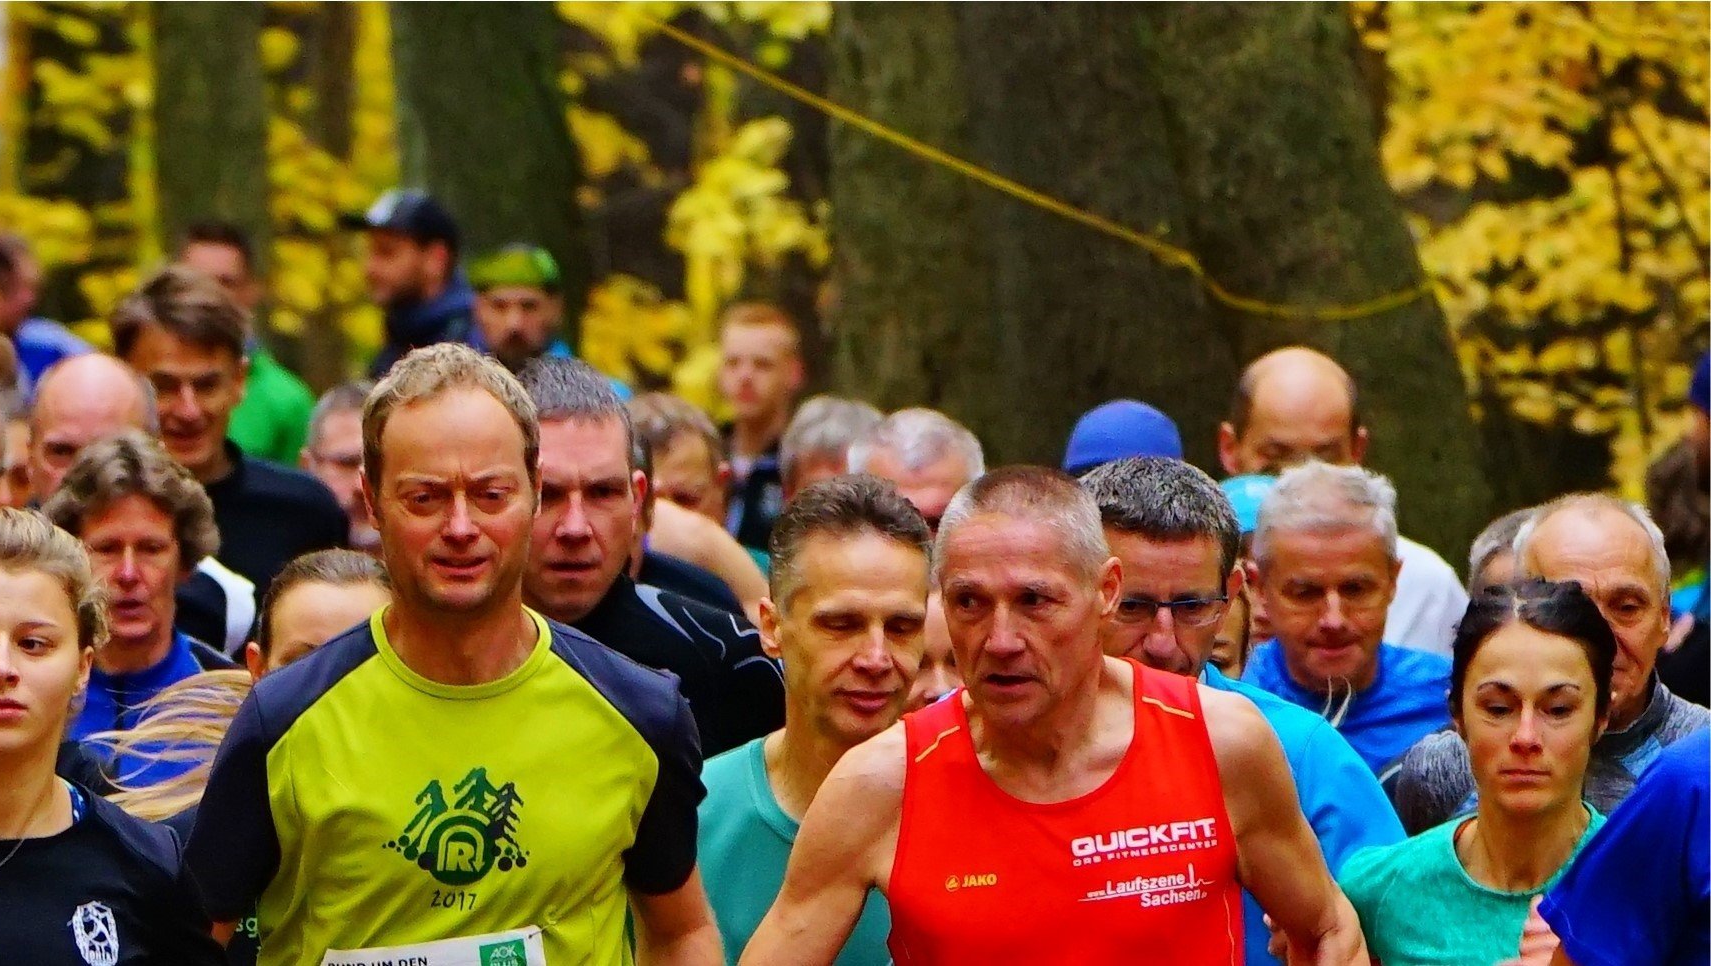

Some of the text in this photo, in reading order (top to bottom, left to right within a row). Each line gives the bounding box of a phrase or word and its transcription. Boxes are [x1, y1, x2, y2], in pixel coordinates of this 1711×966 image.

[1071, 818, 1215, 857] QUICKFIT
[1107, 839, 1217, 860] FITNESSCENTER
[962, 873, 997, 887] JAKO
[431, 890, 477, 911] 2017
[489, 945, 518, 960] AOK
